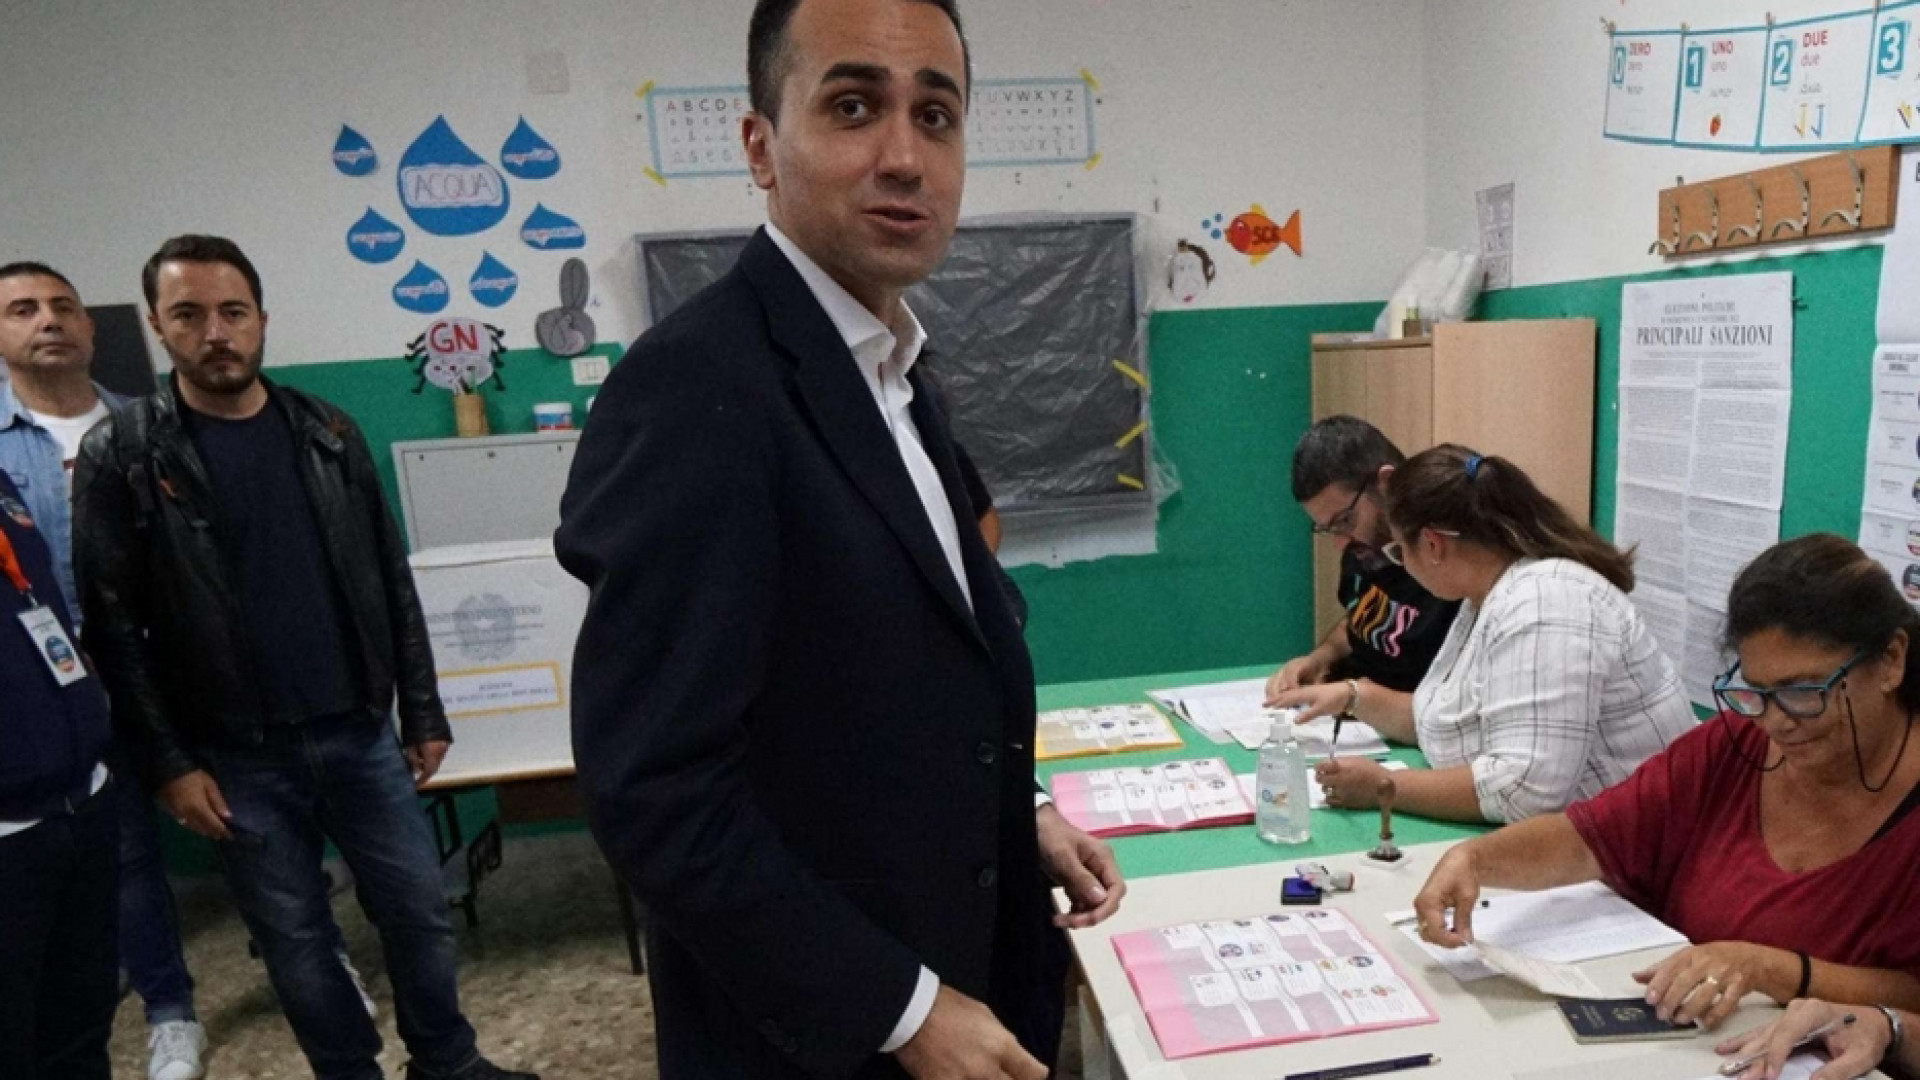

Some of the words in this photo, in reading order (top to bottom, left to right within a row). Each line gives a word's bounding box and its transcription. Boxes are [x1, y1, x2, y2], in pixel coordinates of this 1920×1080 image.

[1712, 41, 1733, 54] UNO
[1803, 31, 1828, 47] DUE
[1880, 27, 1902, 70] 3
[1629, 43, 1652, 56] ZERO
[1689, 51, 1699, 85] 1
[1773, 44, 1789, 80] 2
[667, 101, 676, 111] A
[684, 101, 693, 111] B
[700, 99, 710, 111] C
[715, 99, 726, 111] D
[1004, 91, 1012, 101] V
[1016, 91, 1030, 101] W
[1034, 91, 1043, 101] X
[1050, 91, 1058, 101] Y
[1065, 89, 1073, 101] Z
[414, 172, 493, 202] ACQUA
[430, 322, 478, 352] GN
[1637, 327, 1703, 345] PRINCIPALI
[1710, 325, 1772, 345] SANZIONI
